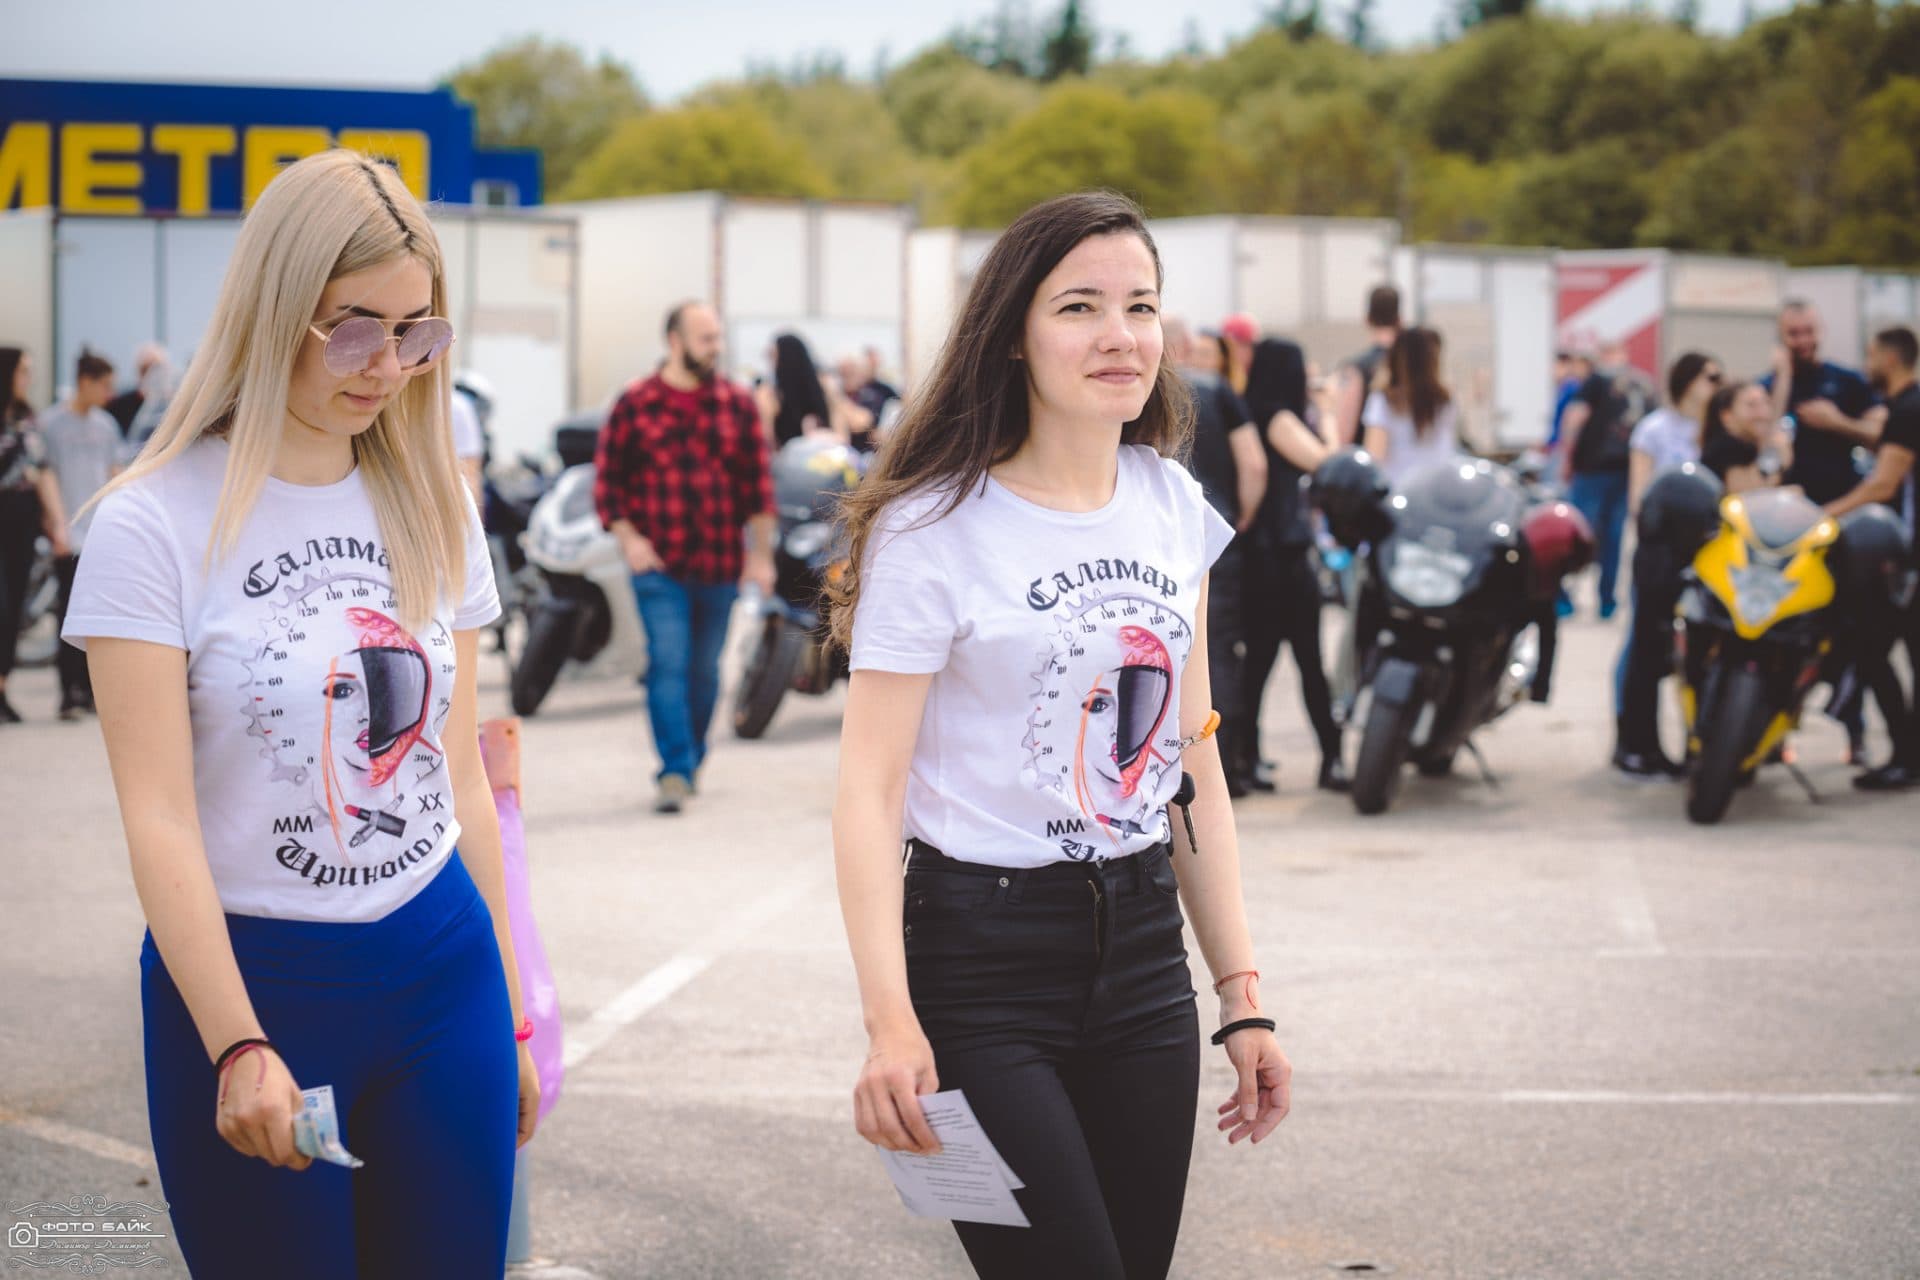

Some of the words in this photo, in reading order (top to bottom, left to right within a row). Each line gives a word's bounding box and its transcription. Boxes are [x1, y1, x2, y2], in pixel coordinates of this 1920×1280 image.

[243, 536, 390, 598] Салама
[1026, 558, 1178, 611] Саламар
[325, 591, 343, 601] 140
[352, 588, 369, 598] 160
[301, 607, 319, 617] 120
[1122, 607, 1138, 617] 160
[1150, 615, 1165, 626] 180
[1082, 624, 1097, 634] 120
[287, 632, 306, 643] 100
[1169, 629, 1183, 640] 200
[273, 651, 287, 661] 80
[1069, 647, 1085, 658] 100
[268, 677, 283, 686] 60
[281, 739, 295, 748] 20
[1042, 746, 1053, 755] 20
[413, 753, 433, 763] 300
[418, 792, 444, 814] XX
